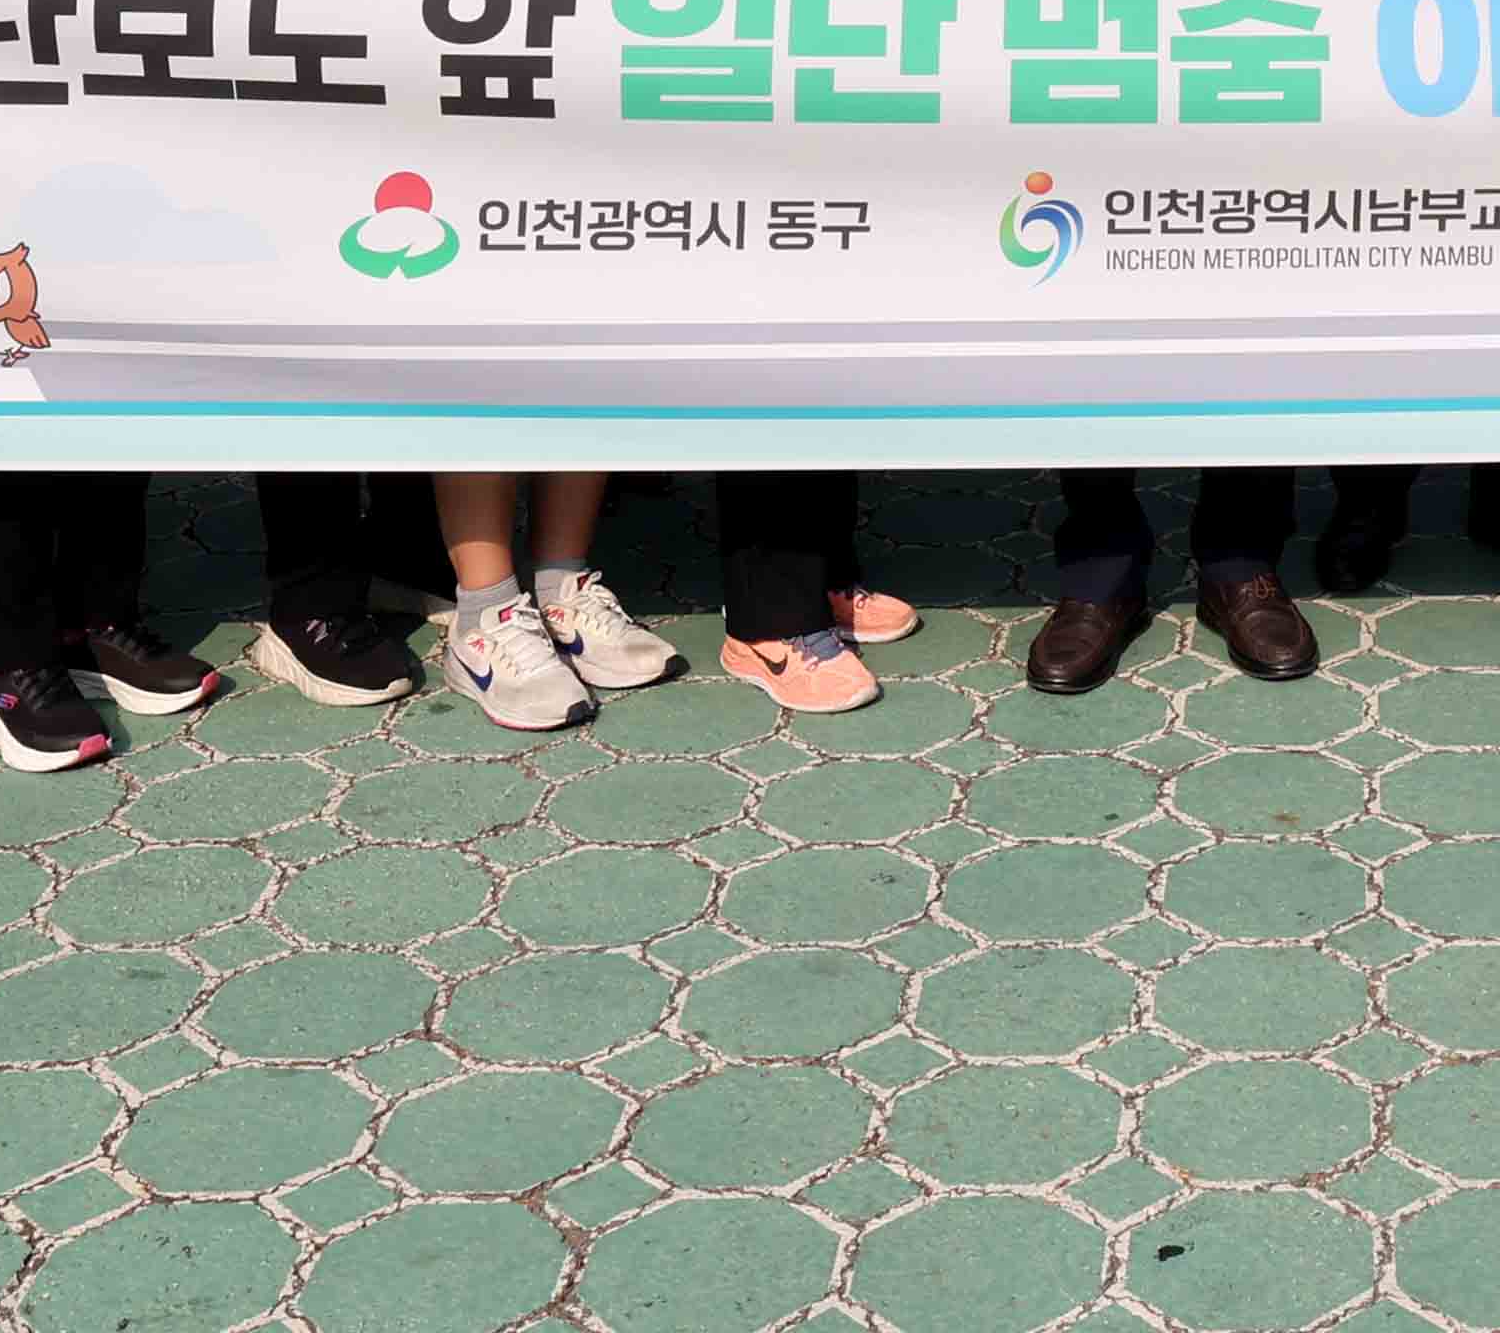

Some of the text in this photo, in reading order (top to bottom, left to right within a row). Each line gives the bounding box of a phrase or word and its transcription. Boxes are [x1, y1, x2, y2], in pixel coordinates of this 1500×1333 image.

[476, 196, 873, 253] 인천광역시 동구
[1105, 247, 1196, 273] INCHEON
[1202, 244, 1363, 272] METROPOLITAN
[1368, 244, 1411, 270] CITY
[1419, 244, 1495, 269] NAMBU
